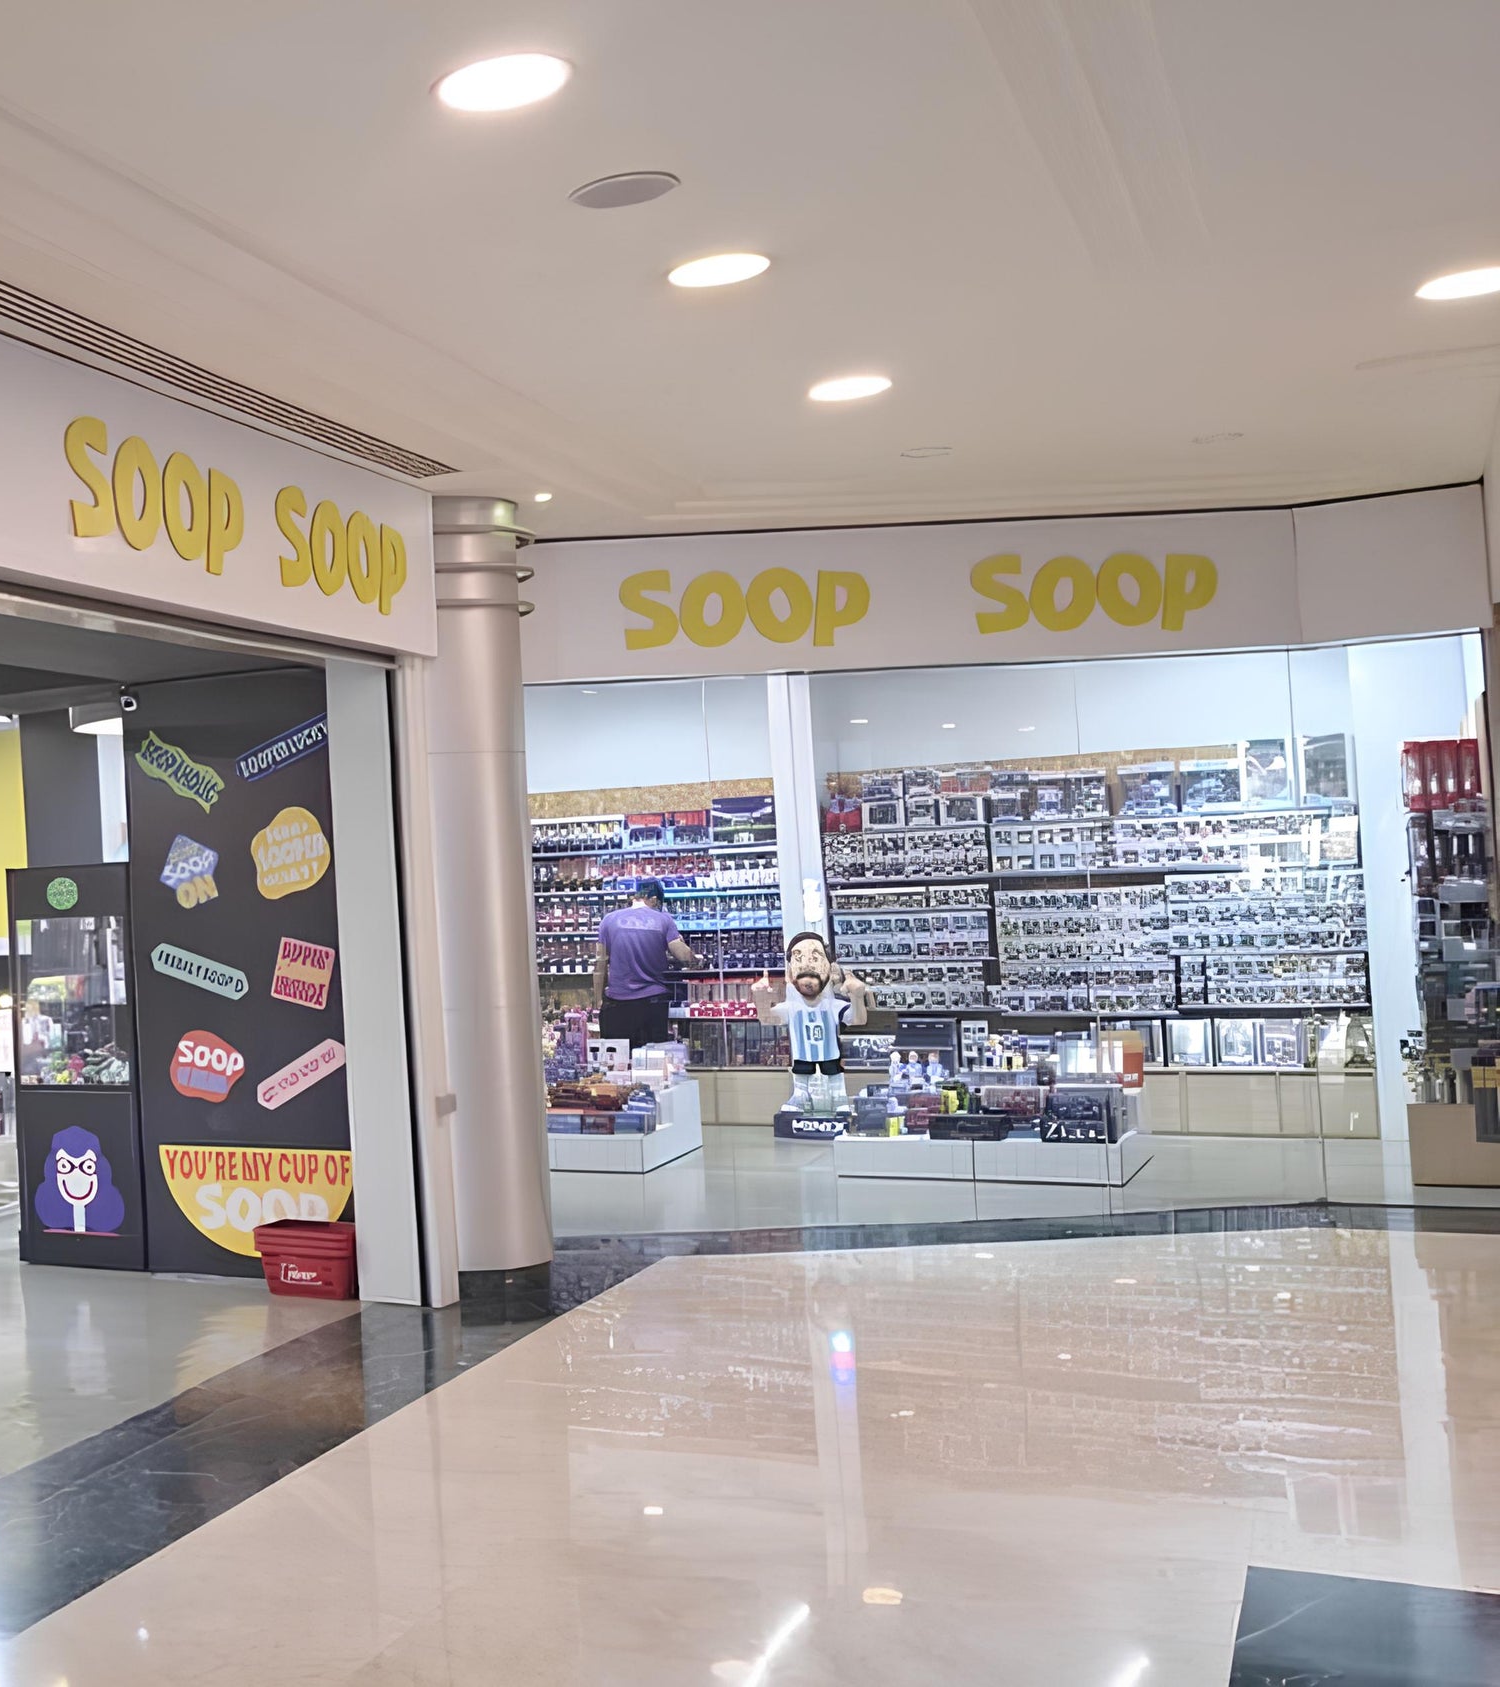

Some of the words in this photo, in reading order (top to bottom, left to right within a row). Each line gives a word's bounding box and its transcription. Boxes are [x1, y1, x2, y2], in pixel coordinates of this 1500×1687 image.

[65, 416, 245, 576] SOOP
[275, 485, 408, 616] SOOP
[620, 568, 870, 651] SOOP
[971, 554, 1218, 635] SOOP
[176, 874, 219, 909] ON
[178, 1040, 245, 1076] SOOP
[165, 1149, 238, 1181] YOU'RE
[278, 1152, 319, 1185] CUP
[324, 1154, 350, 1187] OF
